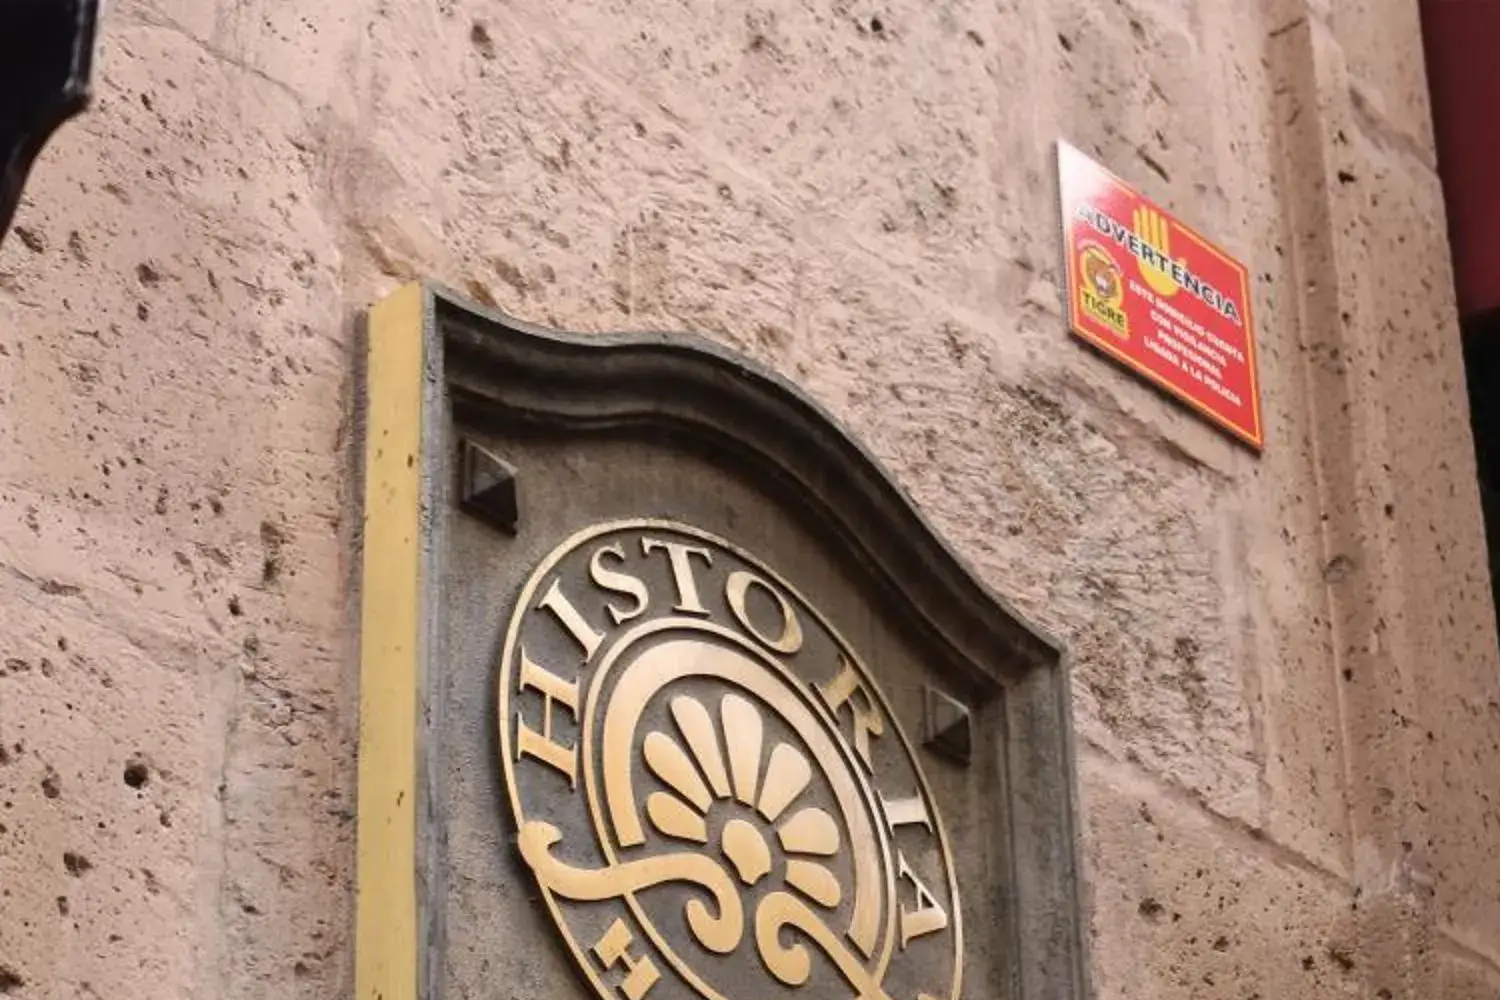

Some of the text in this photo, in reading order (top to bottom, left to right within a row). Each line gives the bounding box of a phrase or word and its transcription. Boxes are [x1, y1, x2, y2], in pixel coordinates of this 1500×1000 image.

[1076, 206, 1242, 327] ADVERTENCIA
[1083, 289, 1124, 325] TIGRE
[517, 537, 947, 950] HISTORIA
